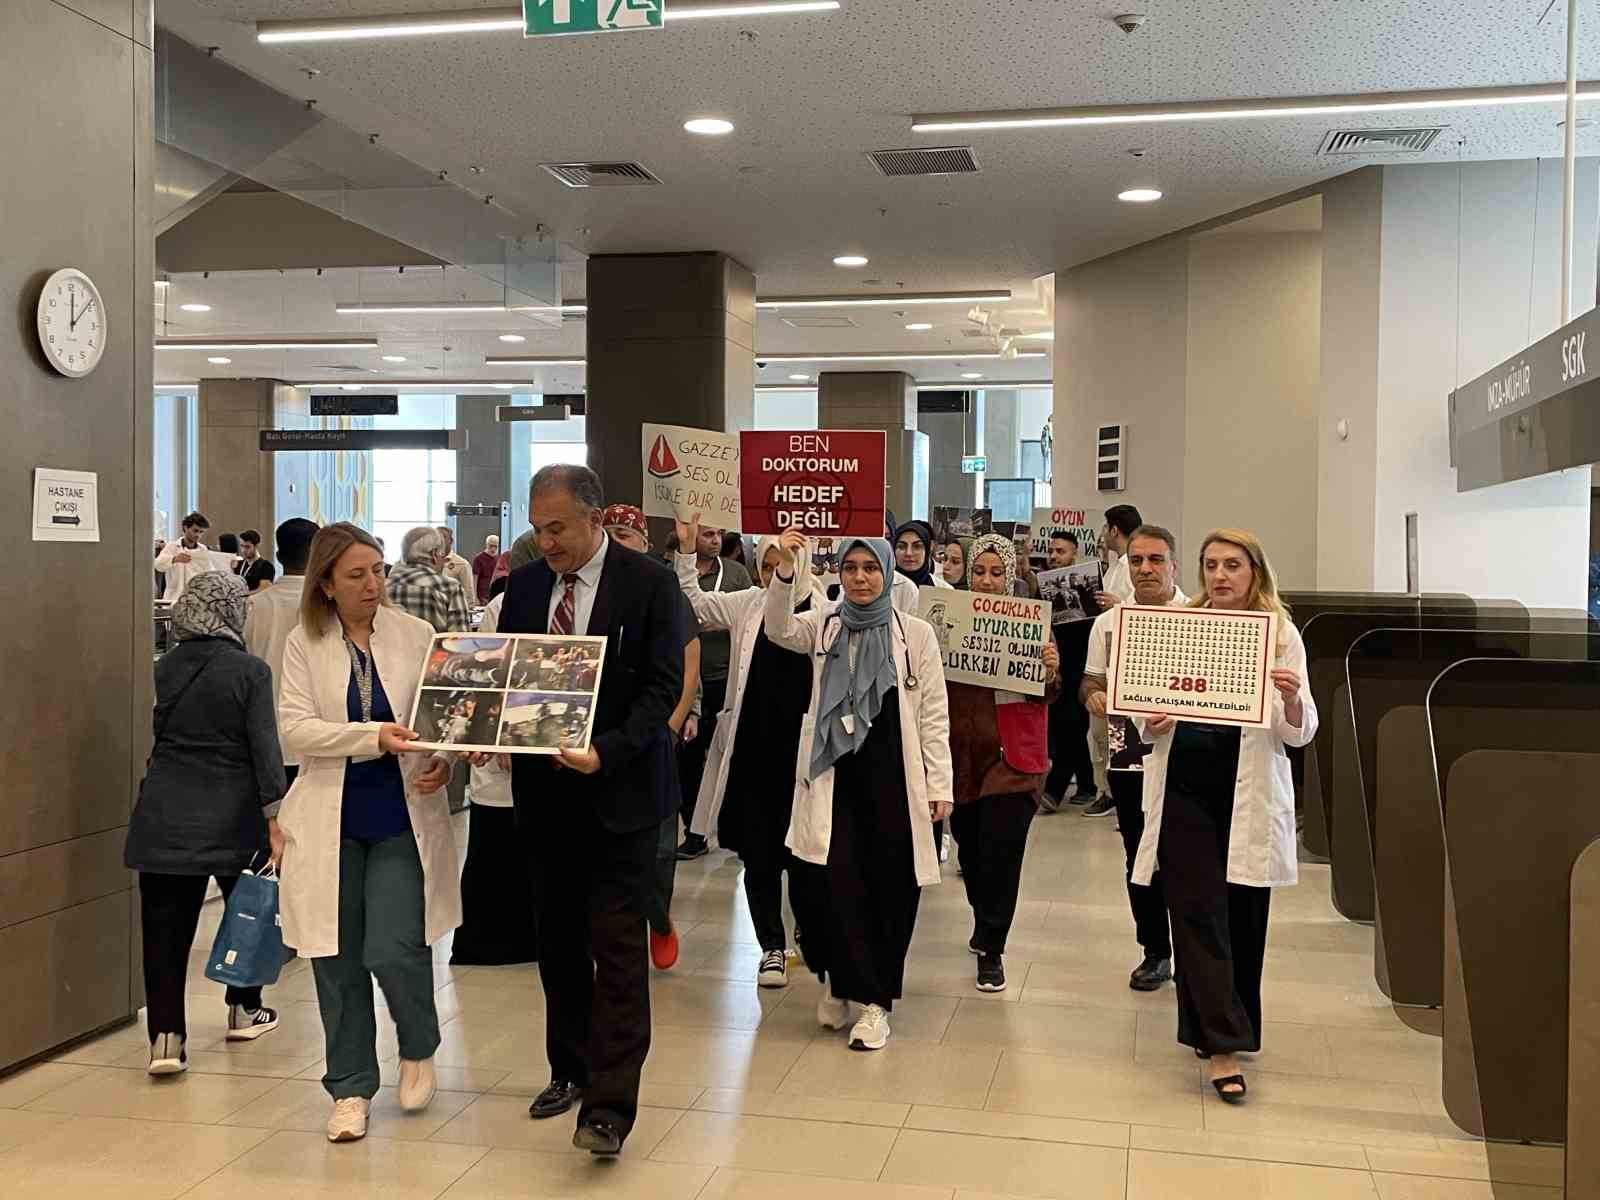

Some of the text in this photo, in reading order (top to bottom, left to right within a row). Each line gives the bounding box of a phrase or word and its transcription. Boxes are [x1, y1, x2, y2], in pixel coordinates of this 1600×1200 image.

[1562, 331, 1585, 381] SGK
[789, 435, 830, 452] BEN
[683, 465, 710, 482] SES
[762, 458, 859, 472] DOKTORUM
[48, 487, 85, 498] HASTANE
[688, 490, 713, 510] DUR
[774, 485, 844, 503] HEDEF
[777, 507, 840, 529] DEĞİL
[1052, 510, 1085, 526] OYUN
[973, 617, 1043, 641] UYURKEN
[1008, 660, 1045, 683] DEĞİL
[1168, 676, 1208, 693] 288
[1123, 694, 1252, 712] SAĞLIK ÇALIŞANI KATLEDİLDİ!
